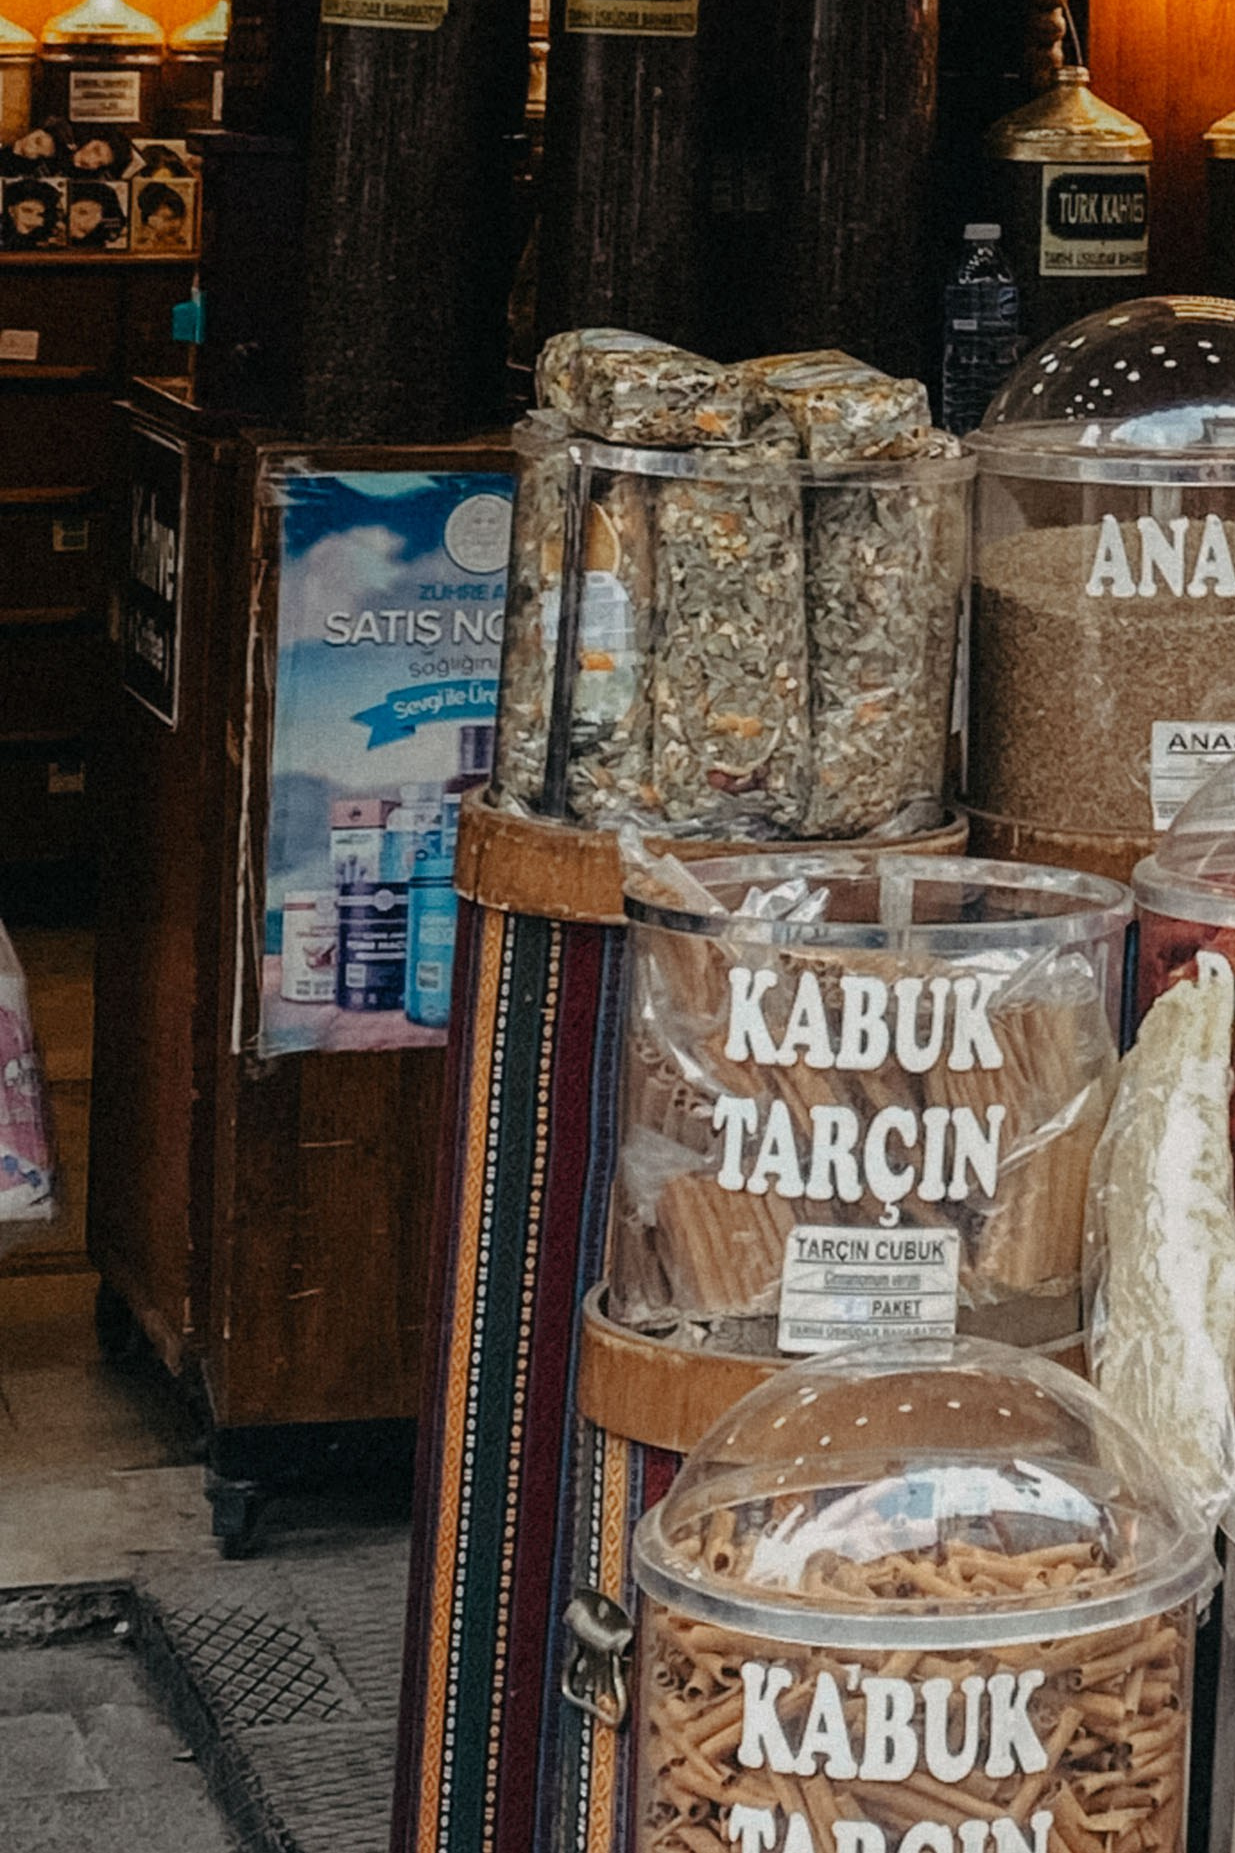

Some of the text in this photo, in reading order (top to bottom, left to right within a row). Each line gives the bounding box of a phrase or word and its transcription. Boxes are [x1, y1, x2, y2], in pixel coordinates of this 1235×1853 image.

[1059, 184, 1099, 224] TÜRK
[324, 609, 444, 655] SATIŞ
[724, 967, 1009, 1073] KABUK
[713, 1094, 1007, 1228] TARÇIN
[796, 1237, 869, 1263] TARÇIN
[871, 1300, 923, 1317] PAKET
[738, 1661, 1049, 1783] KABUK
